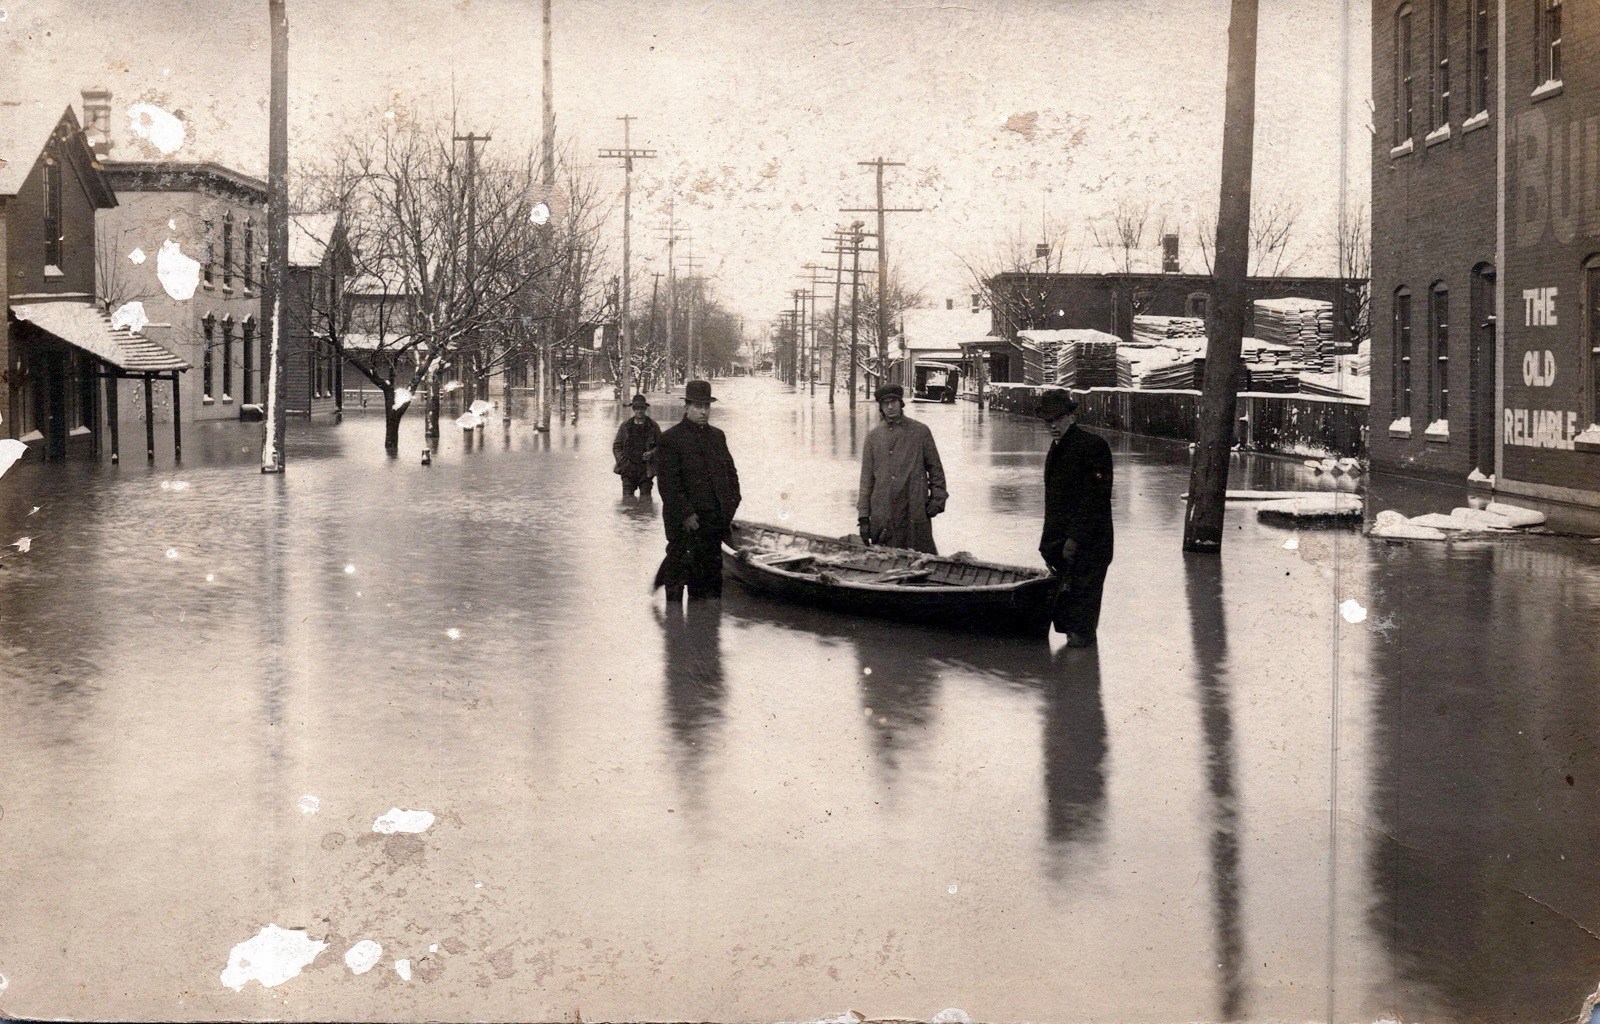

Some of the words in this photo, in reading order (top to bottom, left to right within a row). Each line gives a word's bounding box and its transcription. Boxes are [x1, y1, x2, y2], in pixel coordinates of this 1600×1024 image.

[1522, 287, 1558, 326] THE
[1522, 350, 1556, 386] OLD
[1504, 408, 1577, 450] RELIABLE
